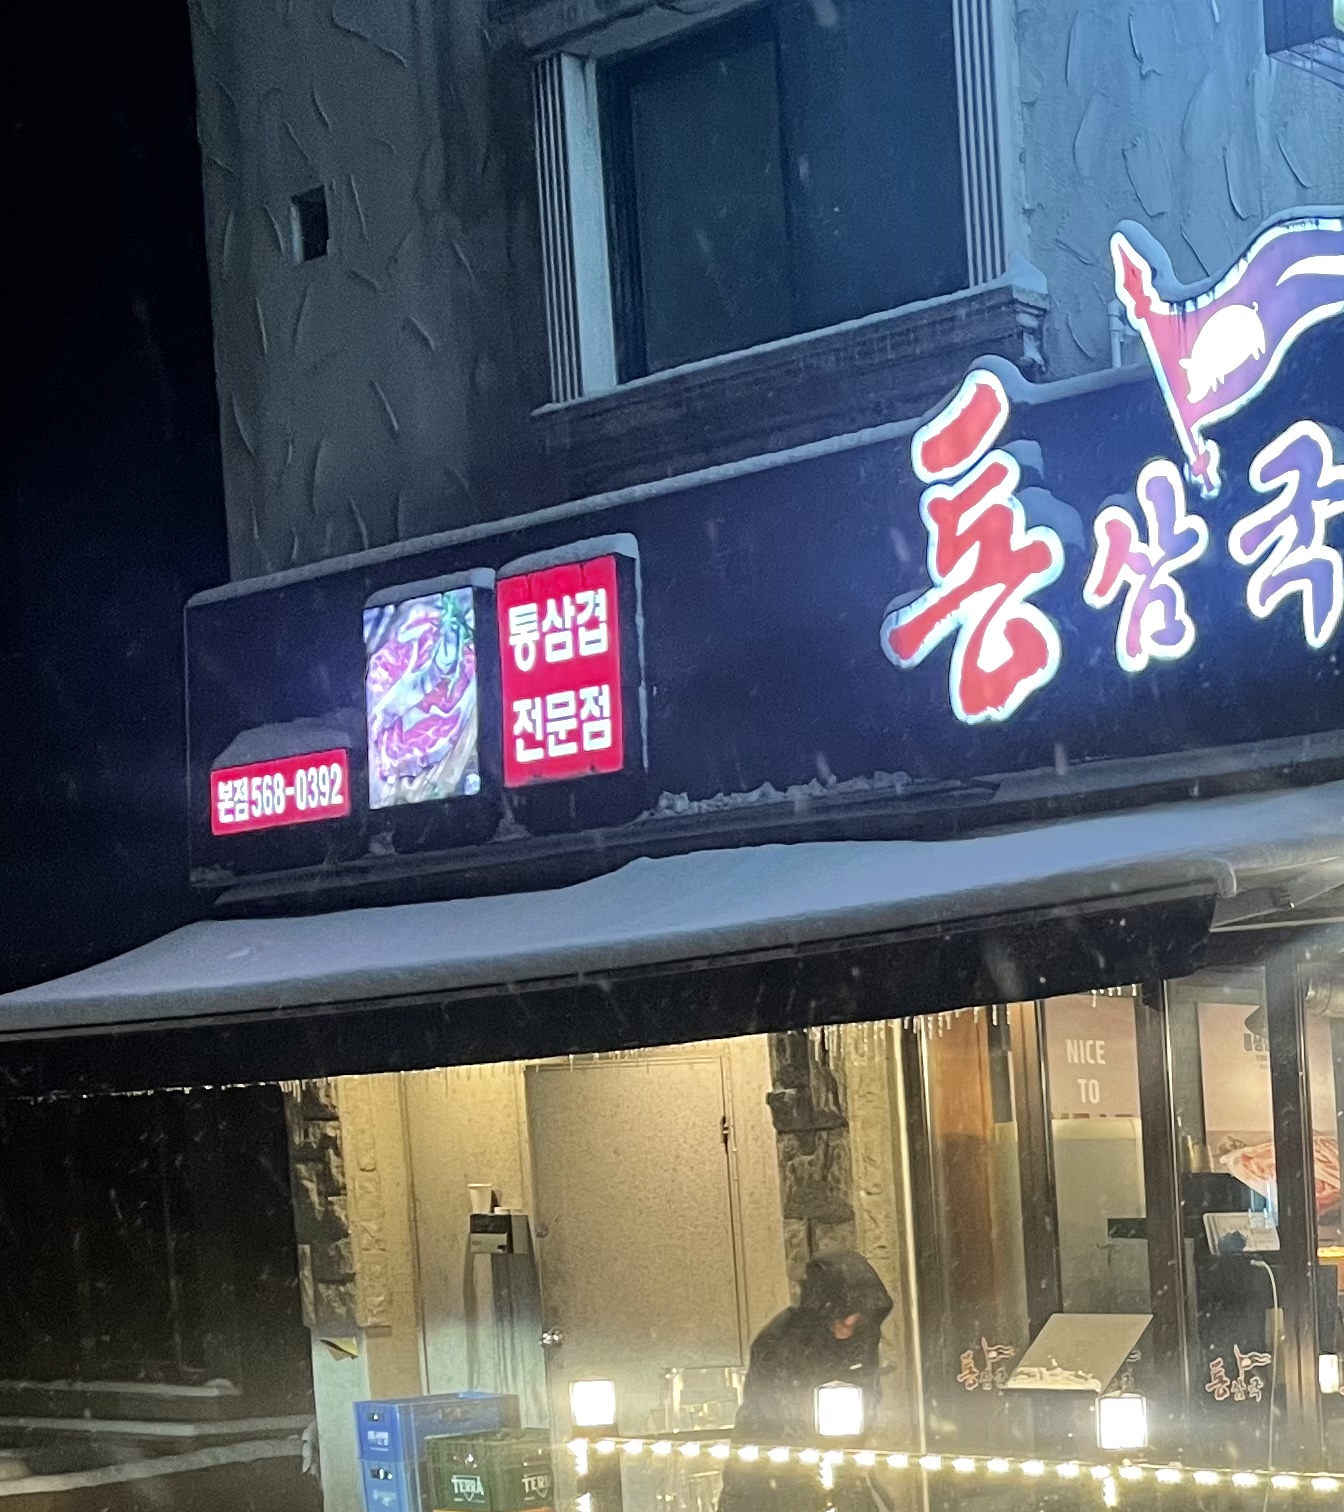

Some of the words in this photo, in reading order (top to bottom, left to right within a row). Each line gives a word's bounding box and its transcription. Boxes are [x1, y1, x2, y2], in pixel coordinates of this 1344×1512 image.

[507, 588, 609, 673] 통삼겹
[512, 682, 613, 764] 전문점
[216, 779, 249, 824] 본점
[251, 761, 343, 818] 568-0392
[1066, 1039, 1106, 1064] NICE
[1077, 1078, 1100, 1104] TO
[451, 1476, 485, 1496] TERRA
